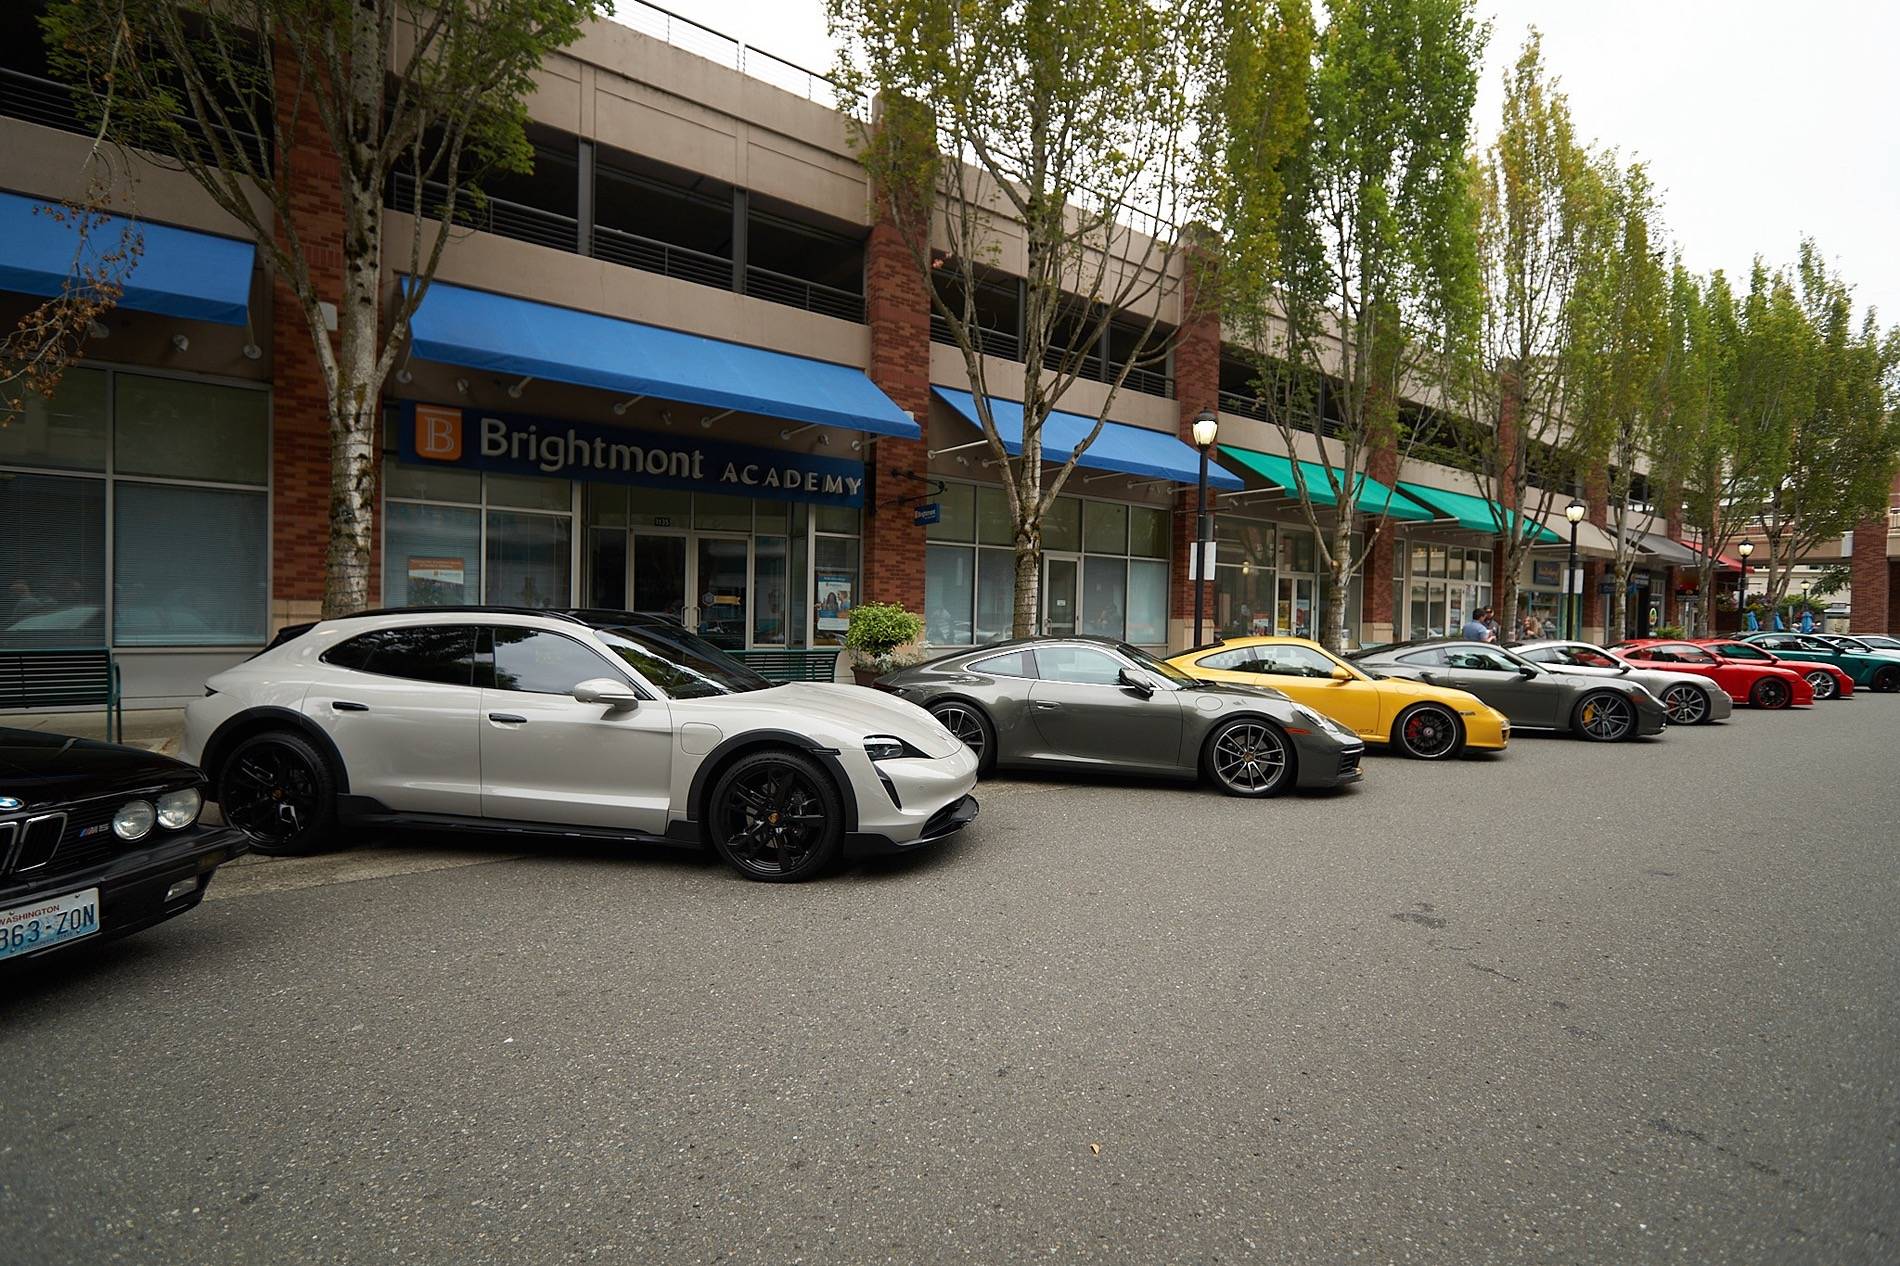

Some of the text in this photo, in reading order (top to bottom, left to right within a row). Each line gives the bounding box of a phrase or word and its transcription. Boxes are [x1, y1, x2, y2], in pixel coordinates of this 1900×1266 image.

[424, 416, 455, 453] B
[480, 417, 863, 496] Brightmont ACADEMY
